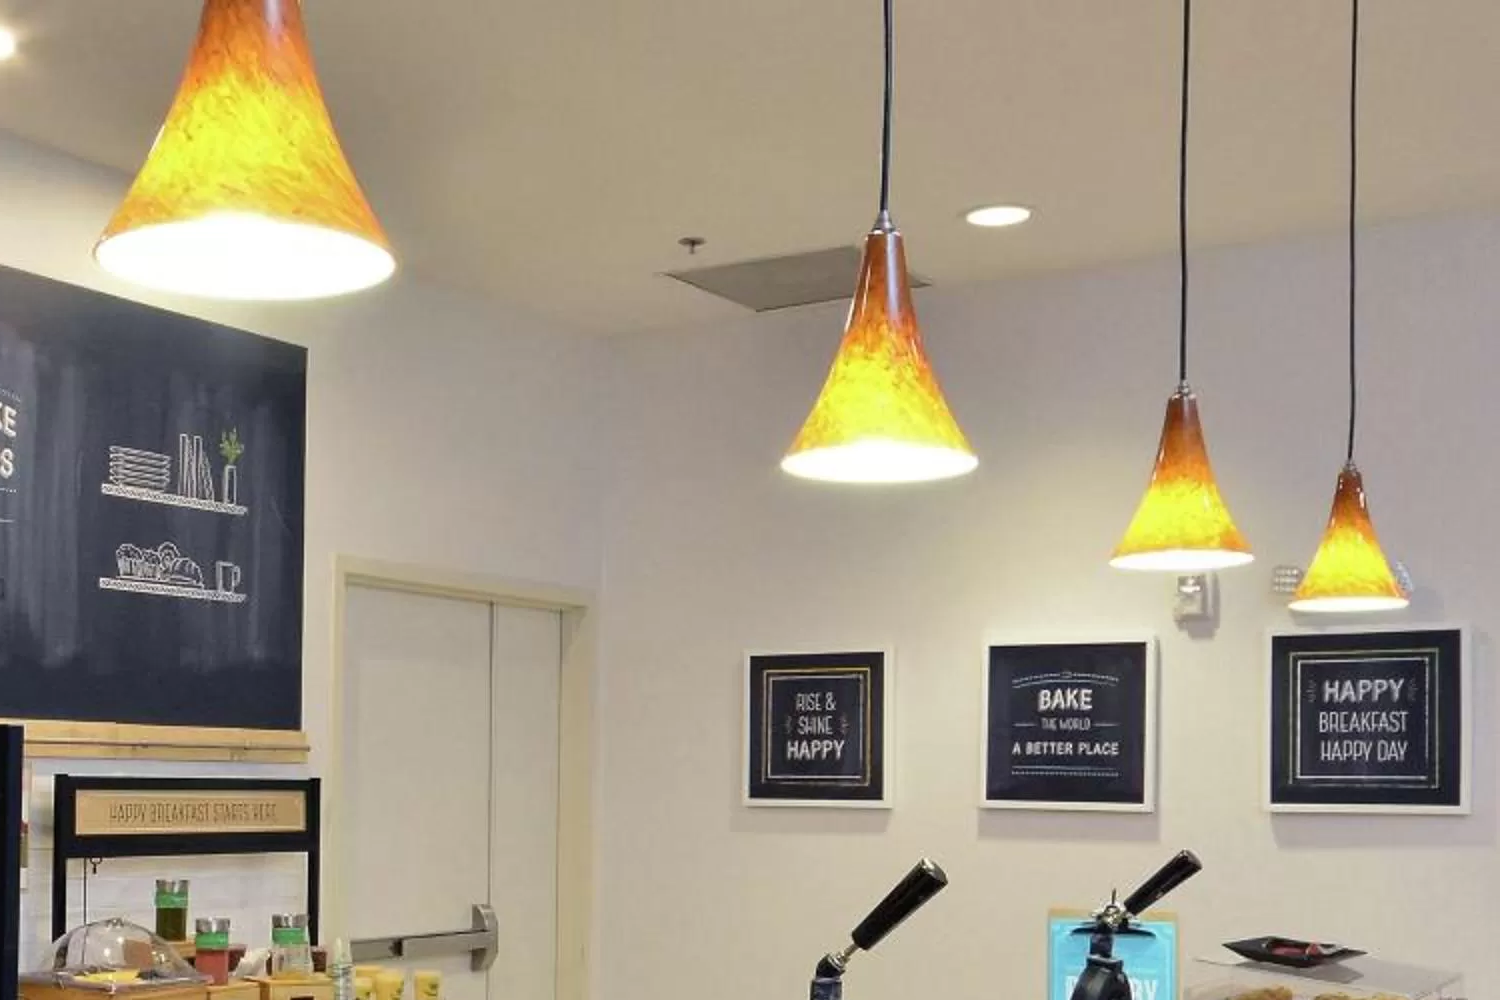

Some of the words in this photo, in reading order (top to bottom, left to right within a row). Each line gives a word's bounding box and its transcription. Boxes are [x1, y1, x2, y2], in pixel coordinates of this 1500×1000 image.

[795, 693, 822, 712] RISE
[825, 691, 837, 711] &
[1038, 687, 1093, 713] BAKE
[1324, 679, 1404, 703] HAPPY
[797, 715, 833, 735] SHINE
[1059, 717, 1092, 731] WORLD
[1319, 711, 1408, 733] BREAKFAST
[786, 739, 845, 760] HAPPY
[1012, 741, 1021, 755] A
[1025, 741, 1073, 755] BETTER
[1078, 742, 1120, 755] PLACE
[1321, 740, 1372, 762] HAPPY
[1376, 740, 1408, 762] DAY
